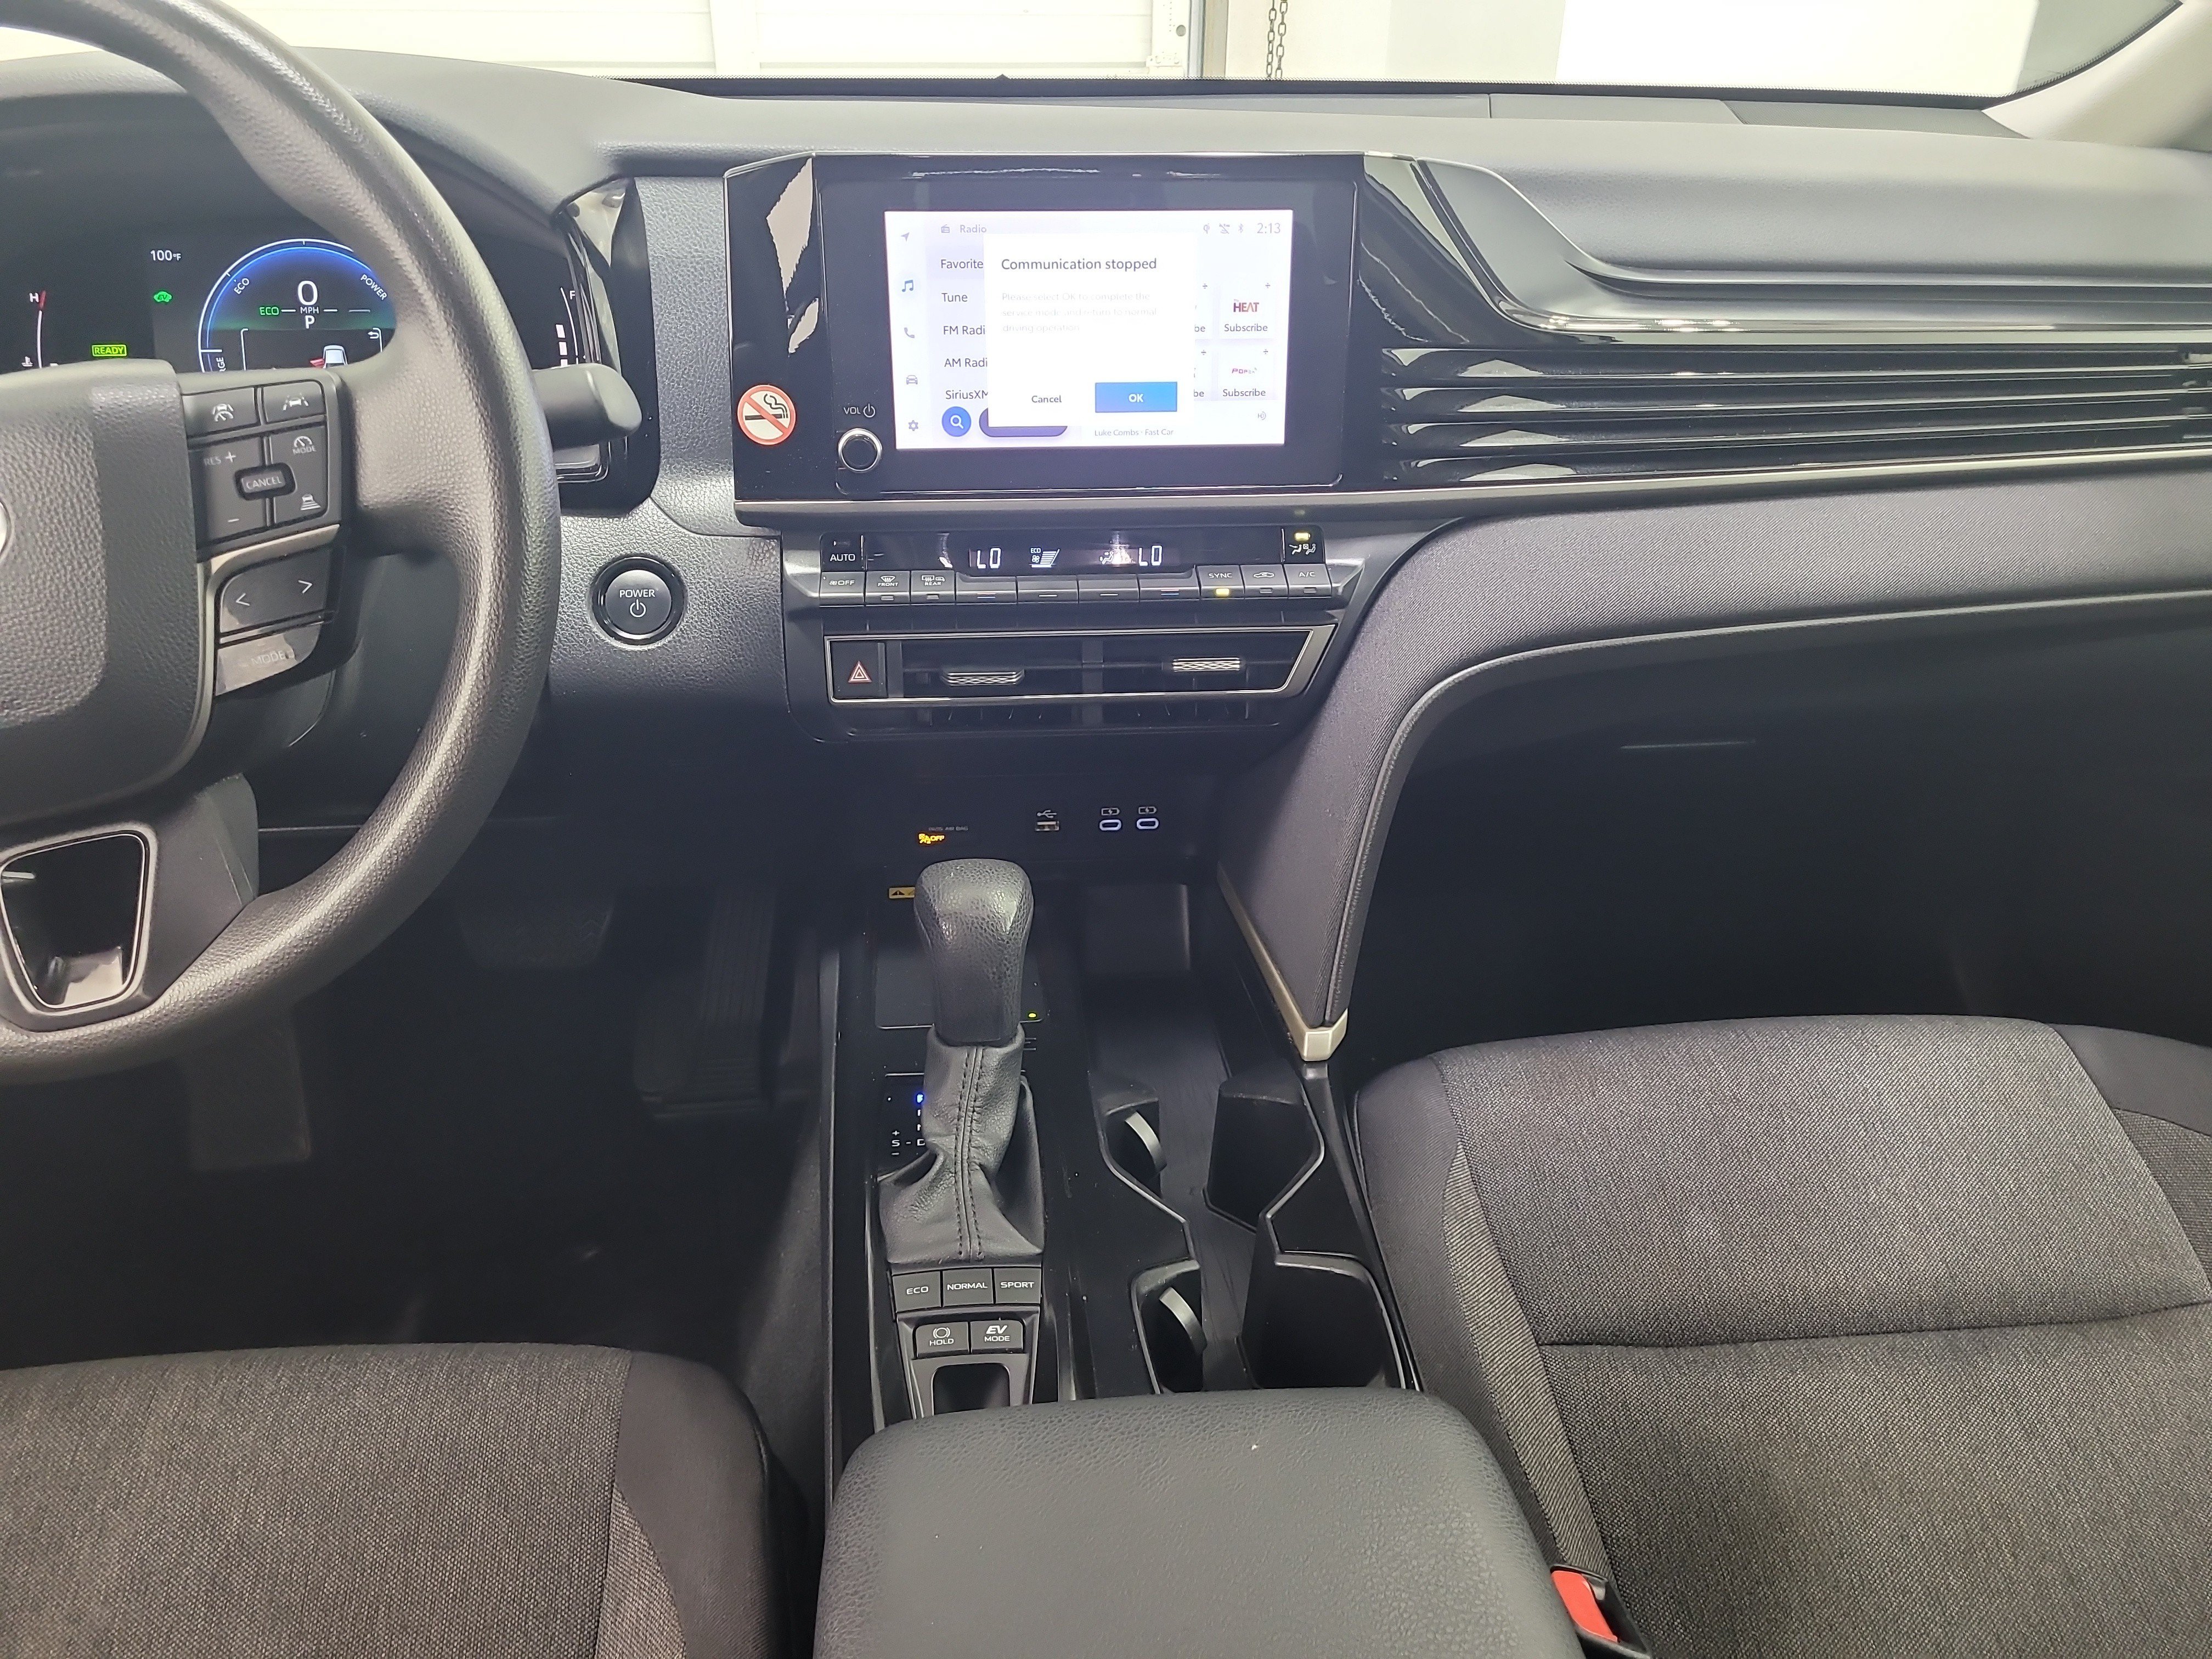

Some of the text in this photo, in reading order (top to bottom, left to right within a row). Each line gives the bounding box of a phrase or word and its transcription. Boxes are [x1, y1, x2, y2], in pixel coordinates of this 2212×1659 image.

[960, 224, 987, 234] Radio
[1256, 222, 1281, 234] 2:13
[1001, 258, 1157, 272] Communication stopped
[233, 277, 250, 295] ECO
[360, 273, 388, 301] POWER
[29, 292, 40, 303] H
[569, 290, 576, 300] F
[941, 292, 968, 302] Tune
[1002, 292, 1031, 301] Please
[1034, 292, 1059, 301] select
[1091, 293, 1133, 302] complete
[259, 307, 280, 315] ECO
[1125, 308, 1157, 316] normal
[1233, 302, 1260, 312] HEAT
[304, 315, 315, 329] P
[943, 325, 986, 335] FM Radi
[1002, 324, 1034, 334] driving
[1224, 323, 1268, 332] Subscribe
[94, 346, 124, 355] READY
[944, 357, 988, 368] AM Radi
[1222, 388, 1266, 397] Subscribe
[1031, 394, 1062, 403] Cancel
[1128, 393, 1144, 403] OK
[843, 407, 861, 415] VOL
[1094, 428, 1112, 437] Luke
[1113, 428, 1139, 437] Combs
[246, 476, 283, 490] CANCEL
[830, 554, 856, 562] AUTO
[976, 548, 1001, 569] LO
[1138, 545, 1163, 566] LO
[619, 589, 656, 599] POWER
[891, 1139, 901, 1147] S
[906, 1286, 929, 1295] ECO
[946, 1282, 989, 1290] NORMAL
[985, 1324, 1008, 1334] EV
[929, 1338, 955, 1347] HOLD
